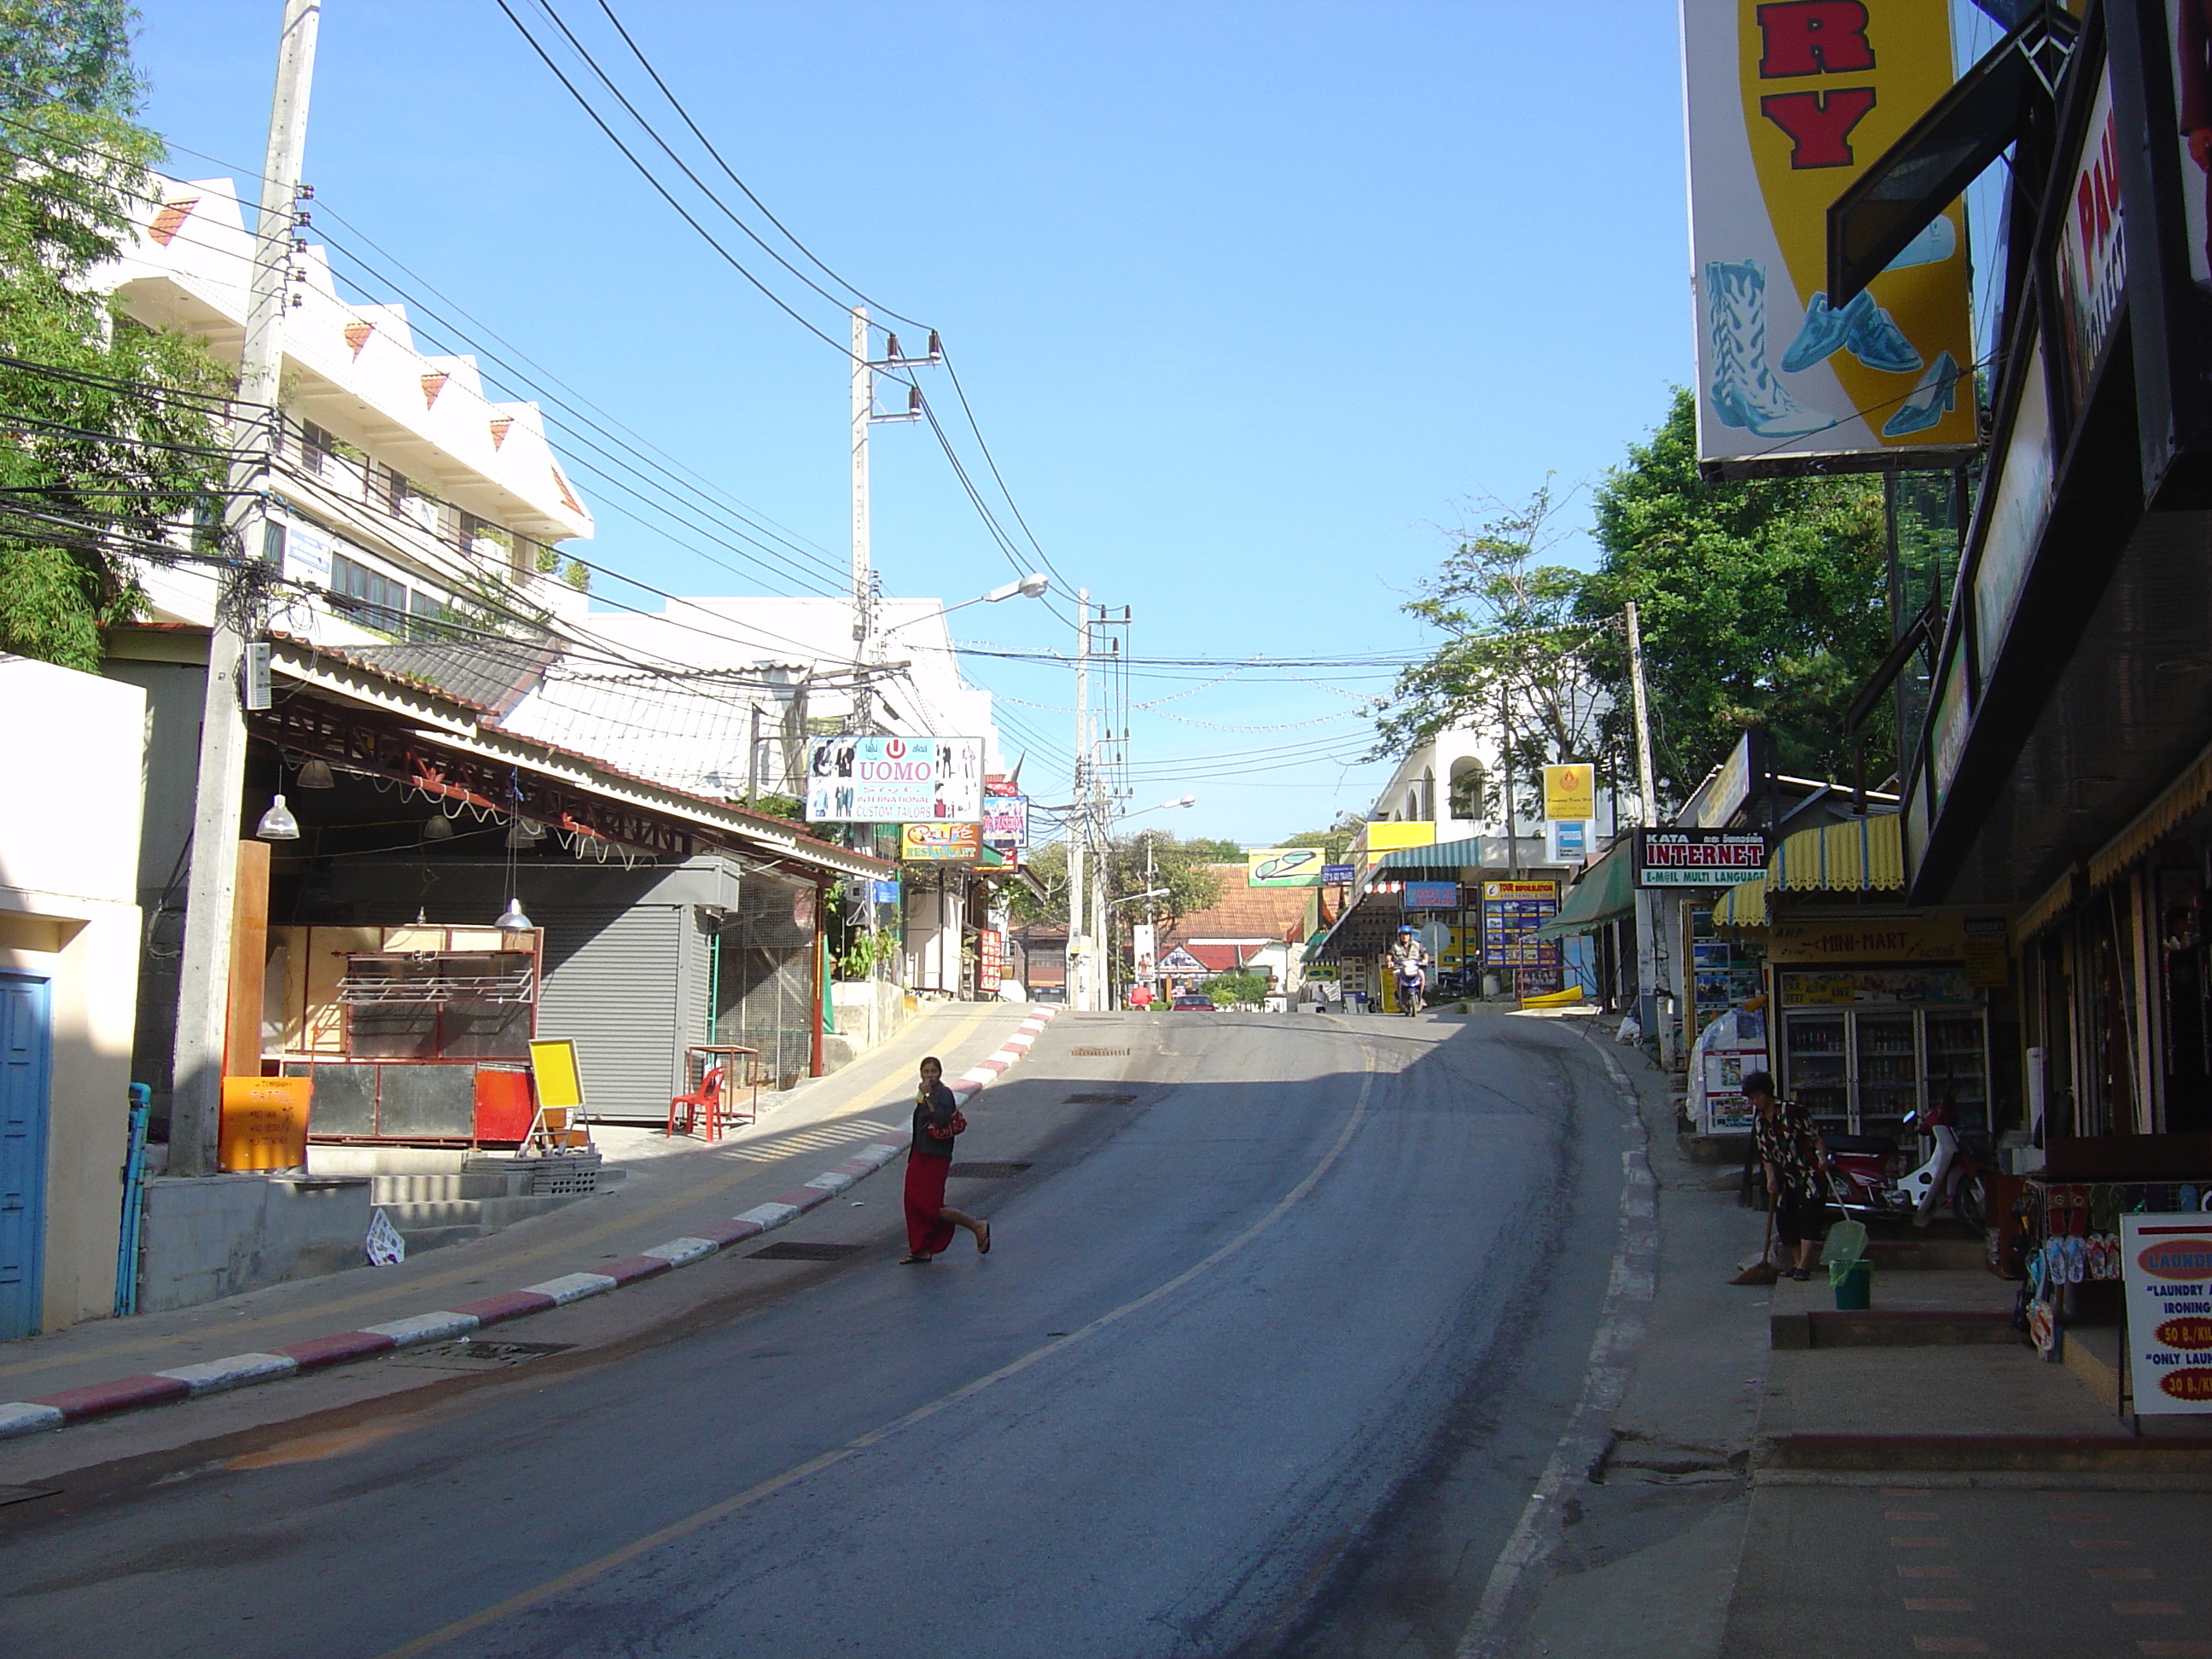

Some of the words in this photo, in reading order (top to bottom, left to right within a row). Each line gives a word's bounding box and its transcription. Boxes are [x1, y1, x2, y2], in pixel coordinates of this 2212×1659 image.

[859, 761, 932, 781] UOMO
[856, 806, 893, 818] CUSTOM
[897, 806, 932, 818] TAILORS
[995, 816, 1024, 831] FASHION
[1646, 834, 1690, 843] KATA
[905, 847, 976, 858] RESTAURANT
[1646, 844, 1764, 866] INTERNET
[1646, 871, 1679, 882] E-M@IL
[1683, 871, 1710, 882] MULTI
[1821, 932, 1909, 952] MINI-MART
[2164, 1327, 2179, 1342] 50
[2168, 1377, 2182, 1393] 30
